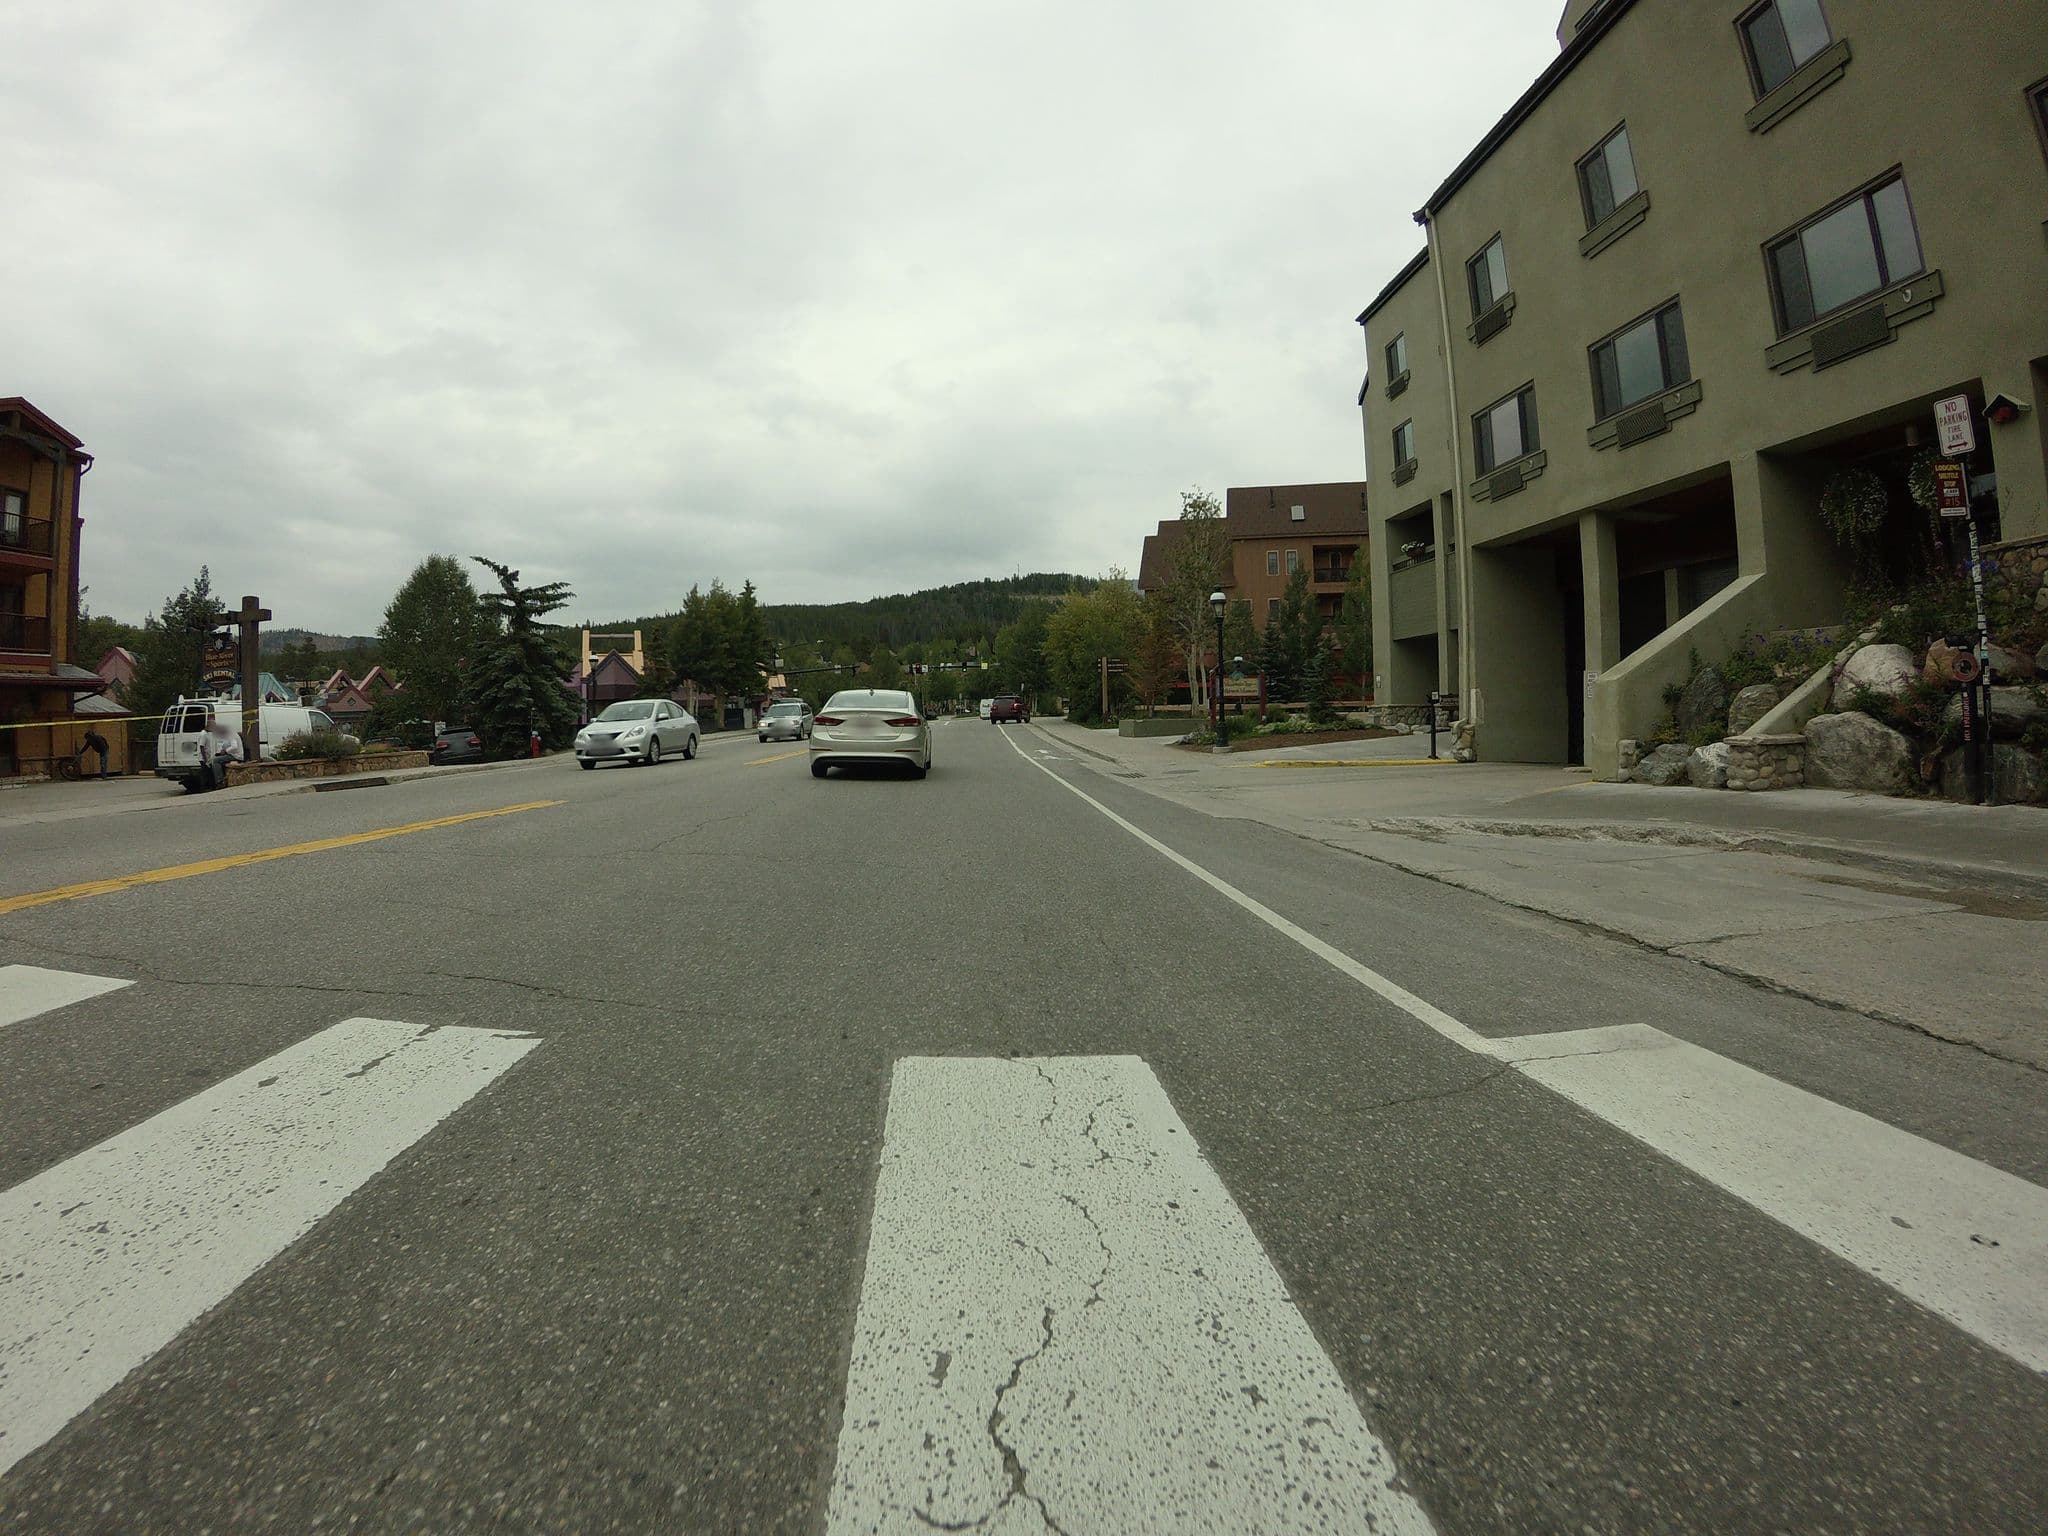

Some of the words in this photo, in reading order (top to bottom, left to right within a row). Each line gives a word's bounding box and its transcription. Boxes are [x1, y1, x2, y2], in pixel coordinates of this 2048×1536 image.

[1944, 401, 1958, 413] NO
[1939, 411, 1968, 426] PARKING
[1948, 425, 1962, 433] FIRE
[1948, 432, 1963, 442] LANE
[203, 671, 213, 682] SKI
[213, 670, 236, 679] RENTAL
